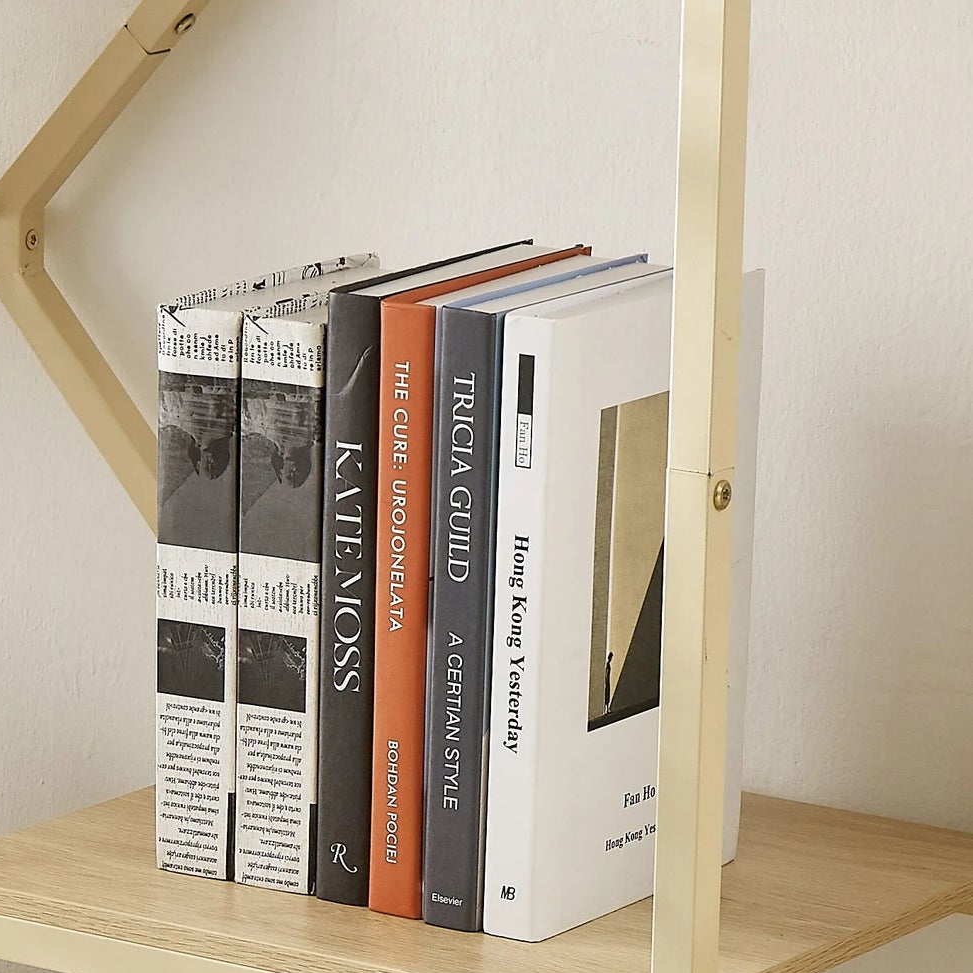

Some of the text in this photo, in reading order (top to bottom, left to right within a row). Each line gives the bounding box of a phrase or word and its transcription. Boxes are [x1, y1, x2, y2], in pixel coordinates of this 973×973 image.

[333, 440, 363, 693] KATE MOSS
[389, 361, 410, 633] THE CURE: UROJONELATA
[447, 372, 476, 583] TRICIA GUILD
[443, 631, 464, 810] A CERTIAN STYLE
[503, 534, 530, 754] Hong Kong Yesterday
[385, 739, 400, 864] BOHDAN POCIEJ
[605, 823, 656, 852] Hong Kong Yes
[624, 784, 656, 808] Fan Ho
[431, 892, 463, 907] Elsevier
